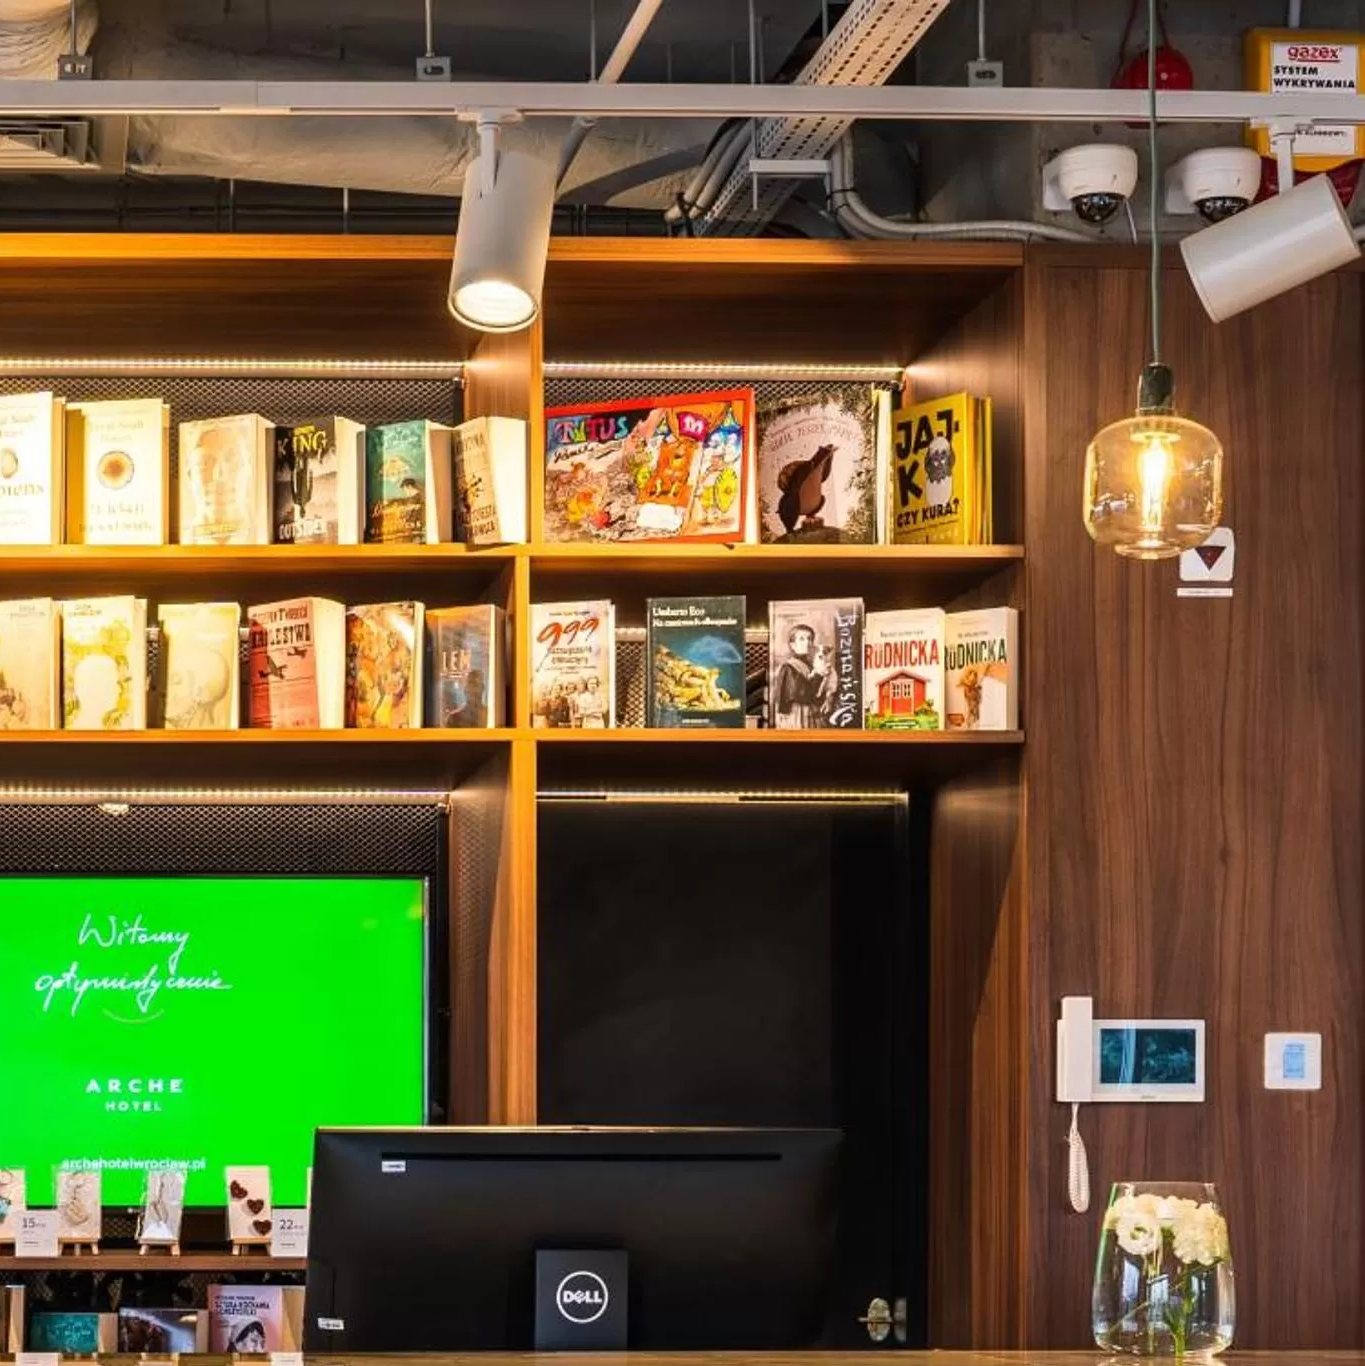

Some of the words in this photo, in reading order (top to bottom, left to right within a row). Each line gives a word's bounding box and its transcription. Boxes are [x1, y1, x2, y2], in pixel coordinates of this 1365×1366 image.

[1287, 46, 1339, 61] gazex
[1273, 65, 1319, 75] SYSTEM
[1273, 78, 1356, 89] WYKRYWANIA
[277, 429, 327, 457] KING
[897, 510, 919, 529] CZY
[536, 618, 600, 672] 999
[441, 650, 472, 672] LEM
[78, 912, 191, 974] Witamy
[85, 1078, 184, 1093] ARCHE
[105, 1101, 163, 1112] HOTEL
[562, 1289, 603, 1305] DELL
